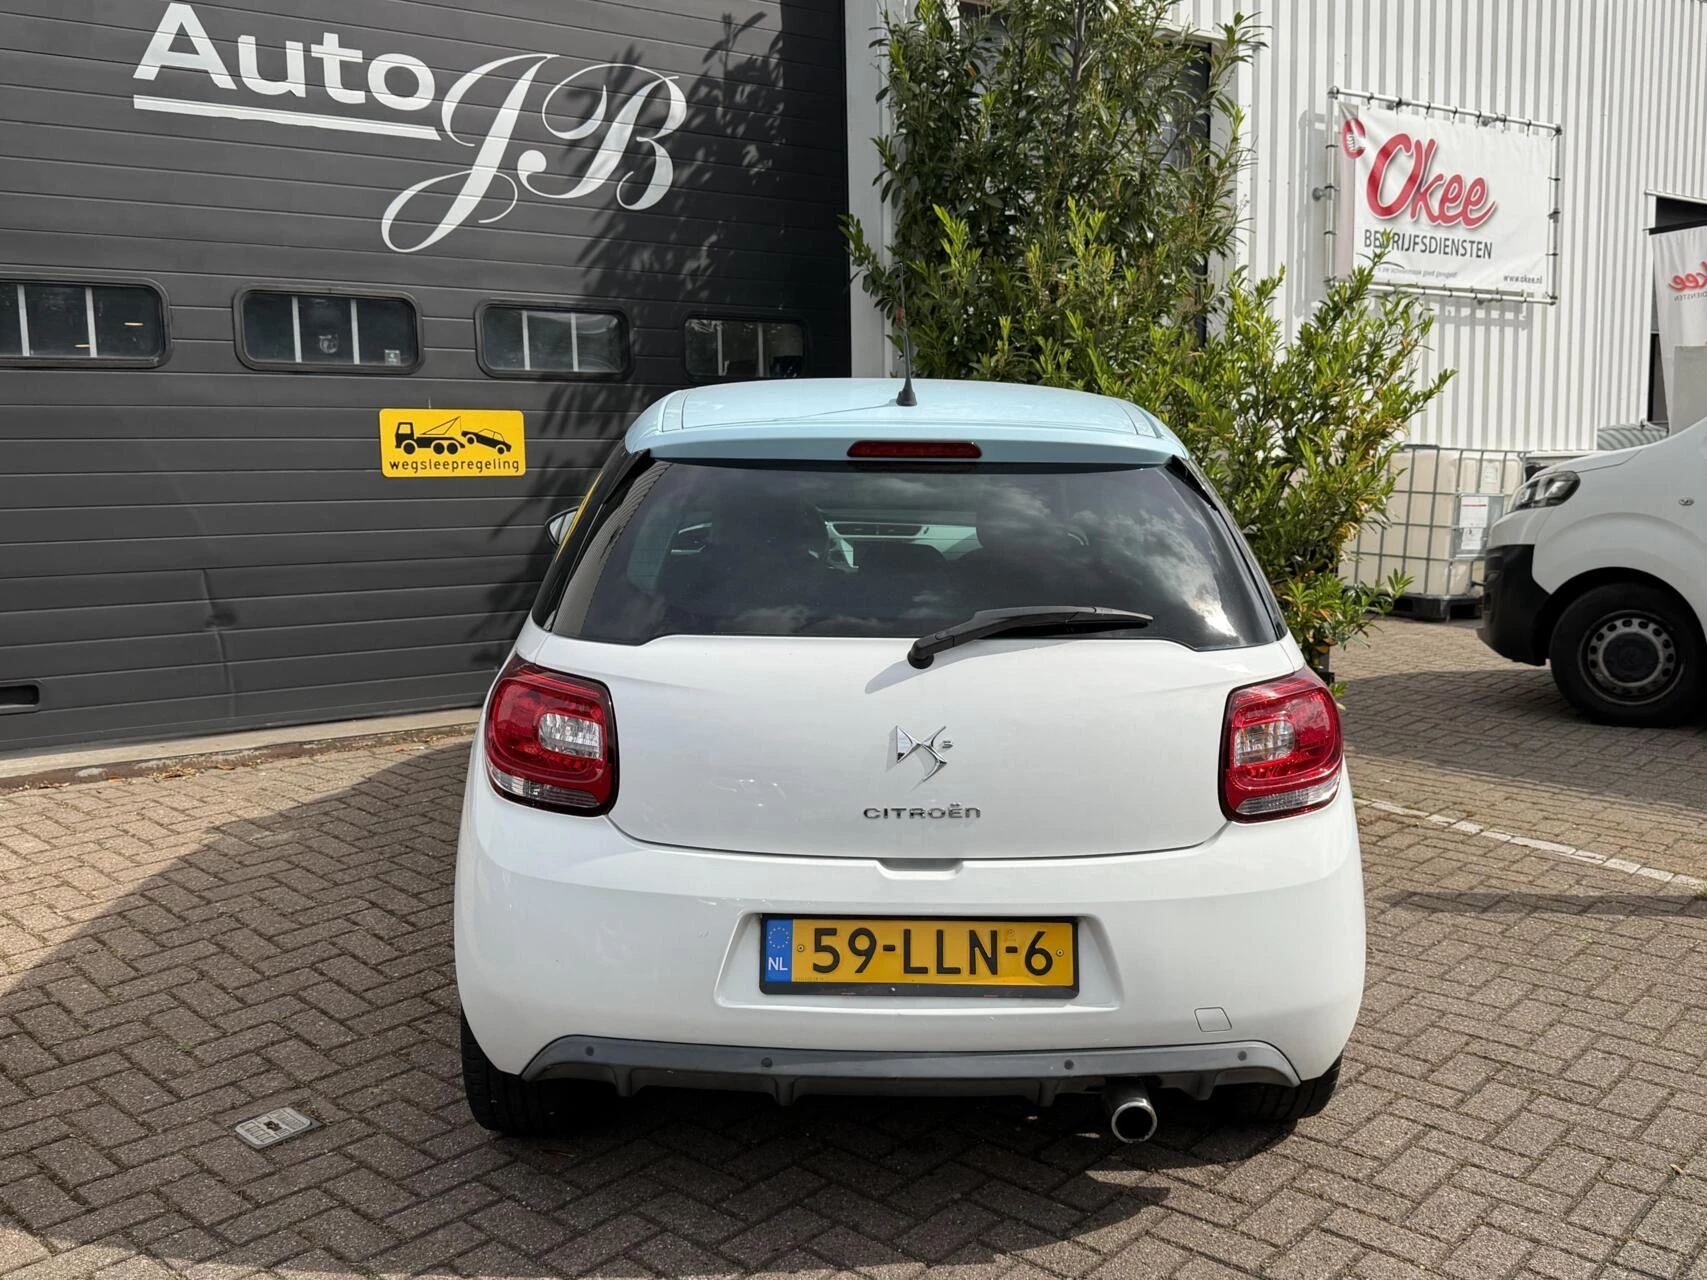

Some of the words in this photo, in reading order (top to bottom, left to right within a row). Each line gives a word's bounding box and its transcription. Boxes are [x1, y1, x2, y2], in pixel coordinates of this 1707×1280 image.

[133, 2, 435, 111] Auto
[381, 54, 687, 253] JB
[389, 458, 519, 474] wegsleepregeling
[768, 957, 788, 972] NL
[812, 927, 1054, 977] 59-LLN-6
